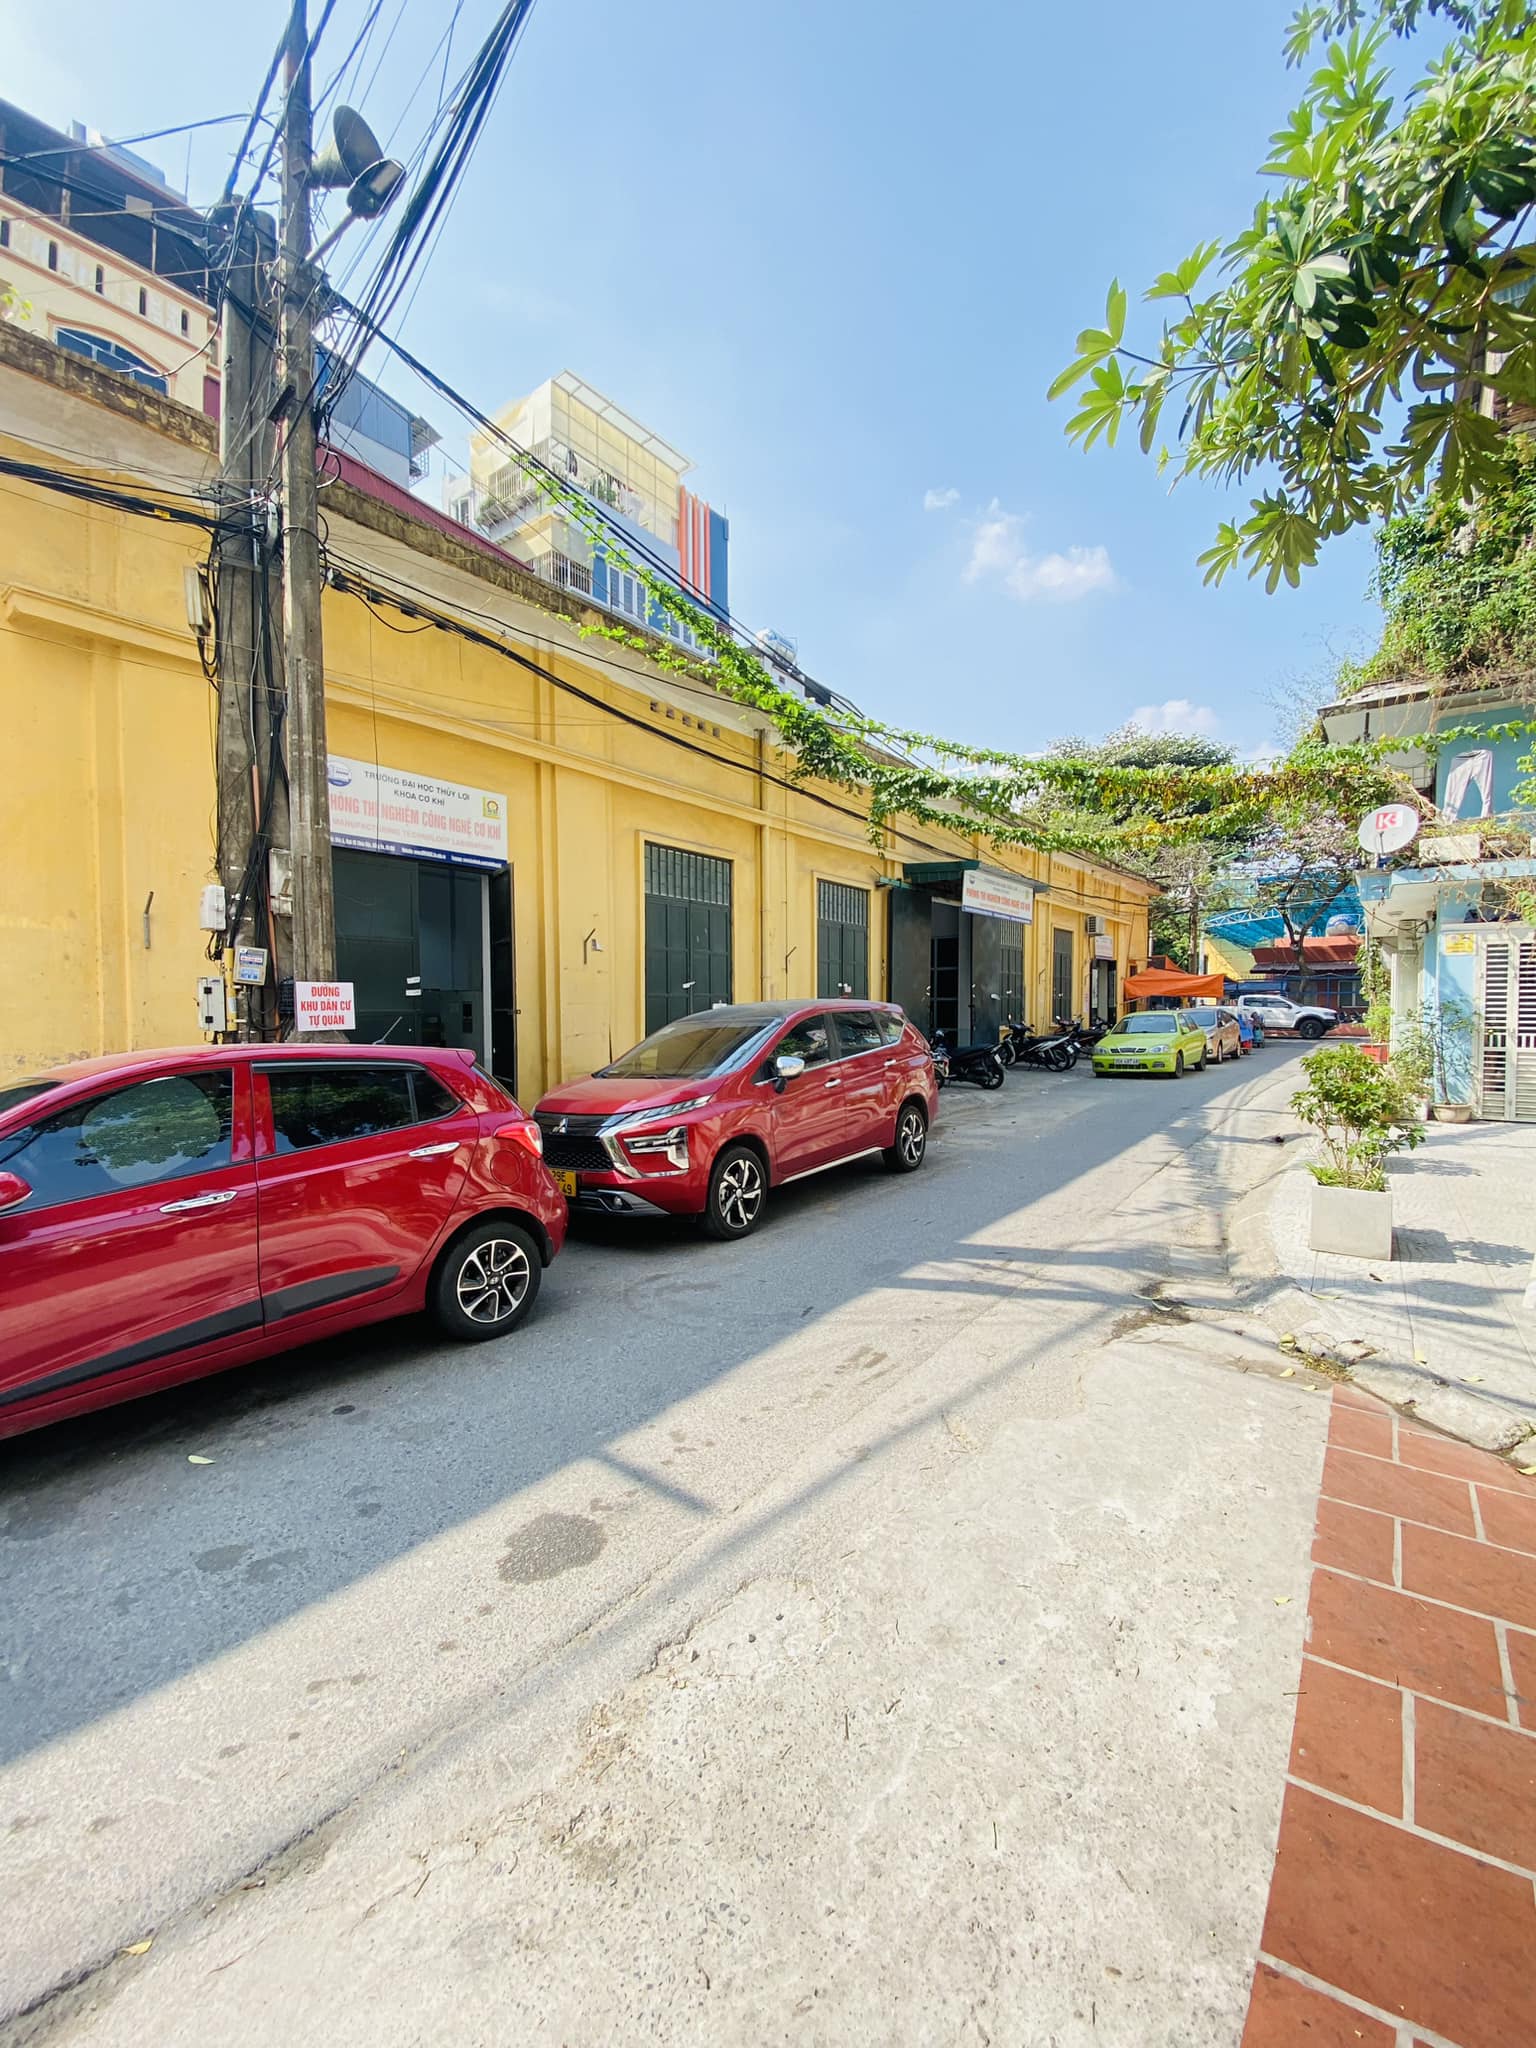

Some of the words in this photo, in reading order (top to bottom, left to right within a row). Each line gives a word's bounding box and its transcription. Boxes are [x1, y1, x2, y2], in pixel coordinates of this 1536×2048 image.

[394, 789, 417, 801] KHOA
[330, 791, 360, 815] HÒNG
[422, 809, 447, 831] CÔNG
[311, 984, 340, 997] ĐƯỜNG
[300, 1000, 318, 1012] KHU
[320, 998, 338, 1011] DÂN
[340, 999, 352, 1011] CƯ
